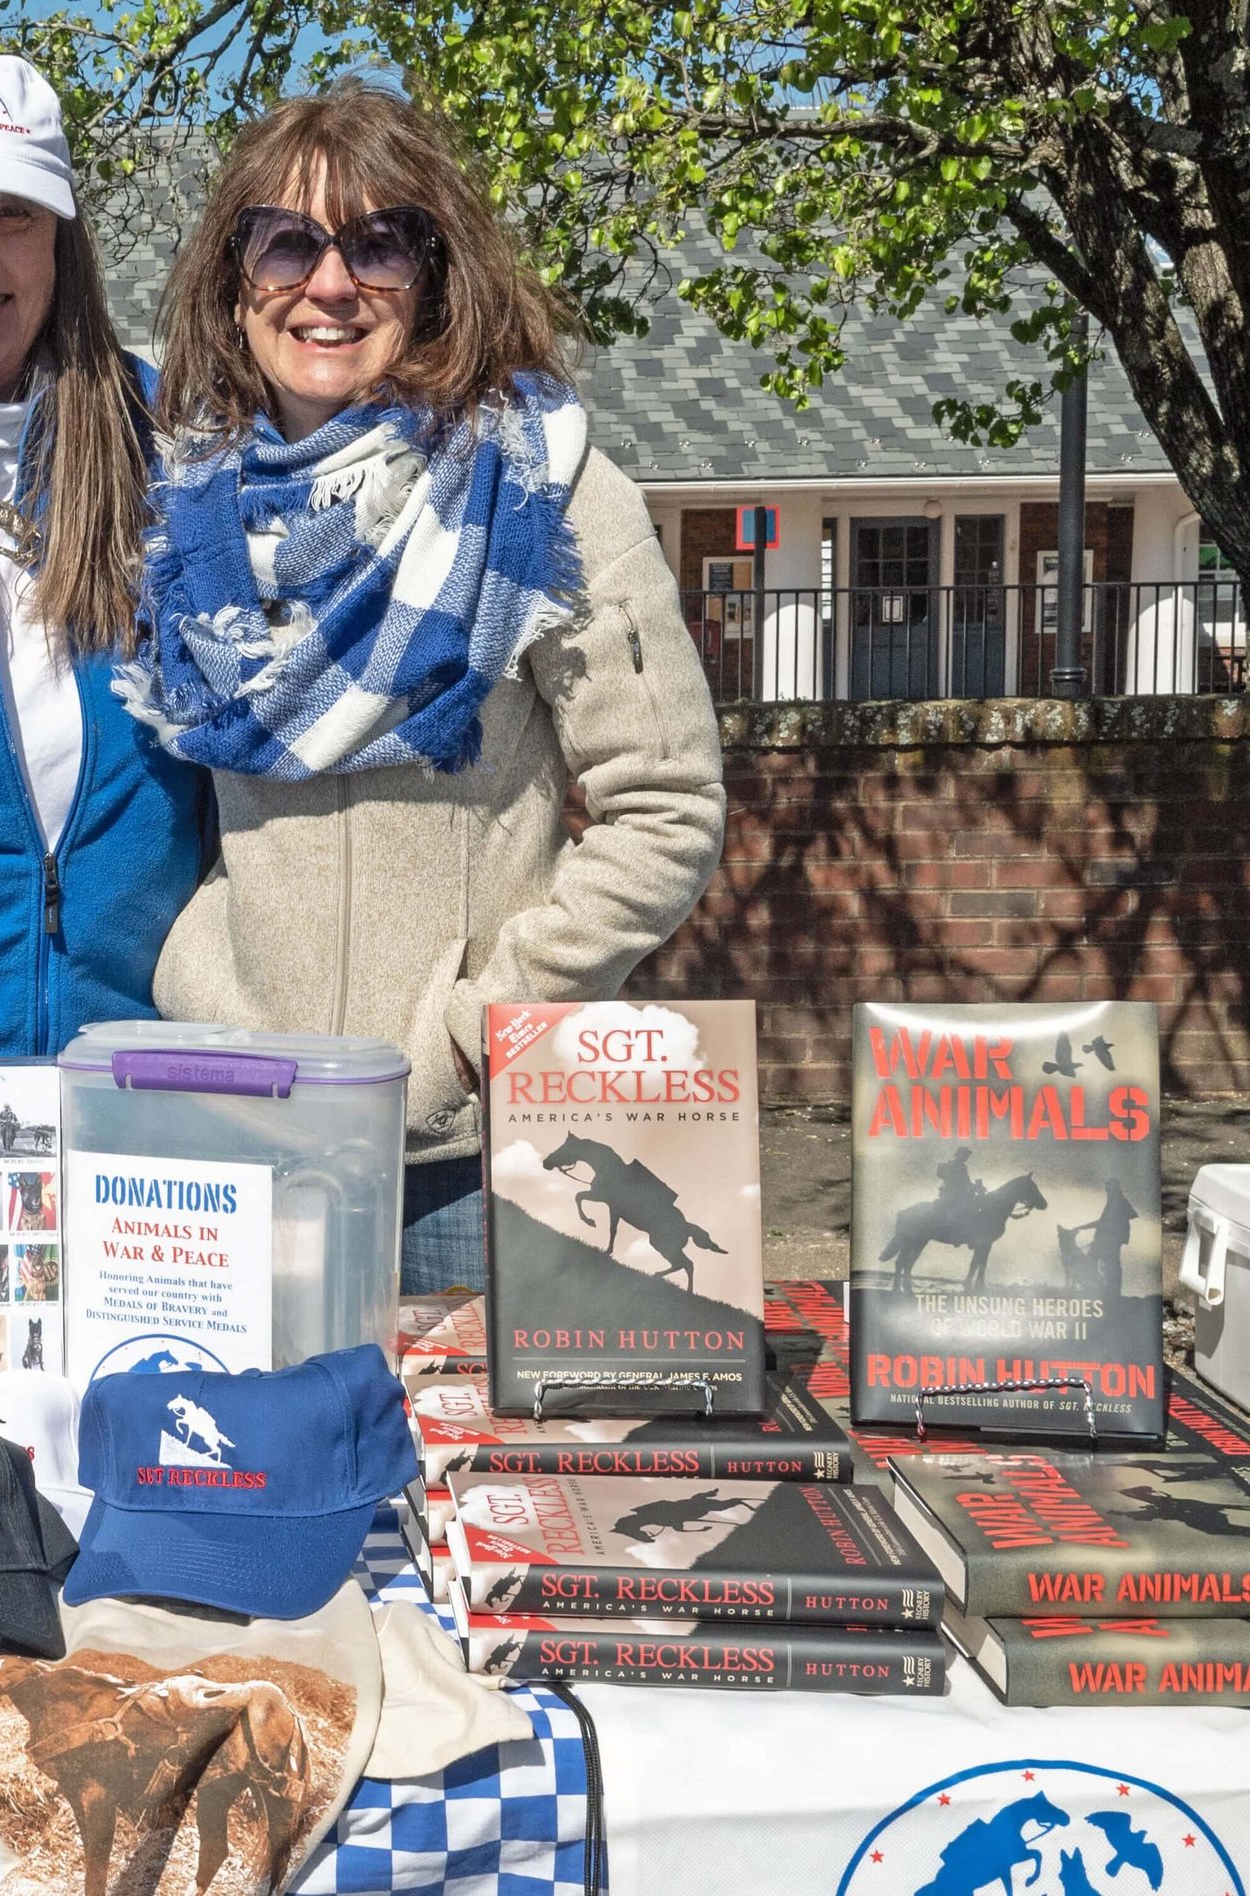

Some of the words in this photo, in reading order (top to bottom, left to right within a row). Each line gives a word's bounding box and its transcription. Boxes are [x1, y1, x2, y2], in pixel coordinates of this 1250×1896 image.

[0, 124, 25, 135] PEACE
[505, 1022, 548, 1058] BESTSELLER
[578, 1030, 668, 1063] SGT.
[868, 1026, 1016, 1080] WAR
[167, 1064, 235, 1083] sistema
[507, 1069, 740, 1104] RECKLESS
[508, 1112, 613, 1122] AMERICA'S
[626, 1112, 665, 1122] WAR
[678, 1112, 740, 1122] HORSE
[868, 1084, 1150, 1142] ANIMALS
[95, 1174, 237, 1214] DONATIONS
[112, 1217, 192, 1240] ANIMALS
[199, 1226, 218, 1242] IN
[102, 1240, 143, 1260] WAR
[152, 1246, 164, 1262] &
[172, 1247, 230, 1268] PEACE
[99, 1270, 144, 1285] Honoring
[147, 1274, 186, 1286] Animals
[188, 1277, 208, 1288] that
[210, 1280, 233, 1290] have
[108, 1285, 139, 1296] served
[142, 1289, 158, 1297] our
[162, 1290, 198, 1302] country
[201, 1292, 222, 1302] with
[916, 1293, 947, 1313] THE
[954, 1294, 1026, 1316] UNSUNG
[1032, 1296, 1104, 1318] HEROES
[104, 1297, 143, 1310] MEDALS
[161, 1301, 208, 1316] BRAVERY
[211, 1307, 228, 1318] and
[86, 1308, 160, 1326] DISTINGUISHED
[162, 1315, 204, 1330] SERVICE
[206, 1320, 247, 1334] MEDALS
[931, 1316, 952, 1337] OF
[958, 1316, 1022, 1338] WORLD
[1028, 1319, 1066, 1340] WAR
[1075, 1320, 1087, 1340] II
[514, 1329, 604, 1349] ROBIN
[618, 1330, 745, 1350] HUTTON
[517, 1371, 540, 1380] NEW
[542, 1371, 600, 1380] FOREWORD
[604, 1372, 616, 1380] BY
[618, 1372, 664, 1380] GENERAL
[668, 1372, 700, 1380] JAMES
[713, 1373, 742, 1382] AMOS
[868, 1353, 984, 1388] ROBIN
[997, 1358, 1156, 1398] HUTTON
[440, 1393, 477, 1416] SGT.
[938, 1396, 998, 1408] BESTSELLING
[1002, 1398, 1038, 1410] AUTHOR
[1042, 1399, 1054, 1410] OF
[1059, 1401, 1079, 1412] SGT.
[490, 1452, 542, 1472] SGT.
[558, 1451, 700, 1474] RECKLESS
[728, 1460, 802, 1473] HUTTON
[137, 1466, 163, 1484] SGT
[168, 1468, 266, 1489] RECKLESS
[486, 1494, 528, 1525] SGT.
[522, 1477, 586, 1556] RECKLESS
[956, 1492, 1054, 1548] WAR
[798, 1486, 843, 1527] HUTTON
[828, 1528, 868, 1566] ROBIN
[541, 1574, 599, 1599] SGT.
[616, 1576, 774, 1605] RECKLESS
[806, 1596, 889, 1610] HUTTON
[1028, 1572, 1104, 1602] WAR
[543, 1602, 647, 1612] AMERICA'S
[662, 1605, 699, 1614] WAR
[714, 1608, 774, 1617] HORSE
[540, 1640, 598, 1665] SGT.
[615, 1643, 774, 1672] RECKLESS
[806, 1662, 890, 1678] HUTTON
[542, 1668, 646, 1679] AMERICA'S
[662, 1672, 698, 1681] WAR
[714, 1674, 774, 1684] HORSE
[1068, 1662, 1146, 1693] WAR
[1158, 1662, 1250, 1693] ANIM
